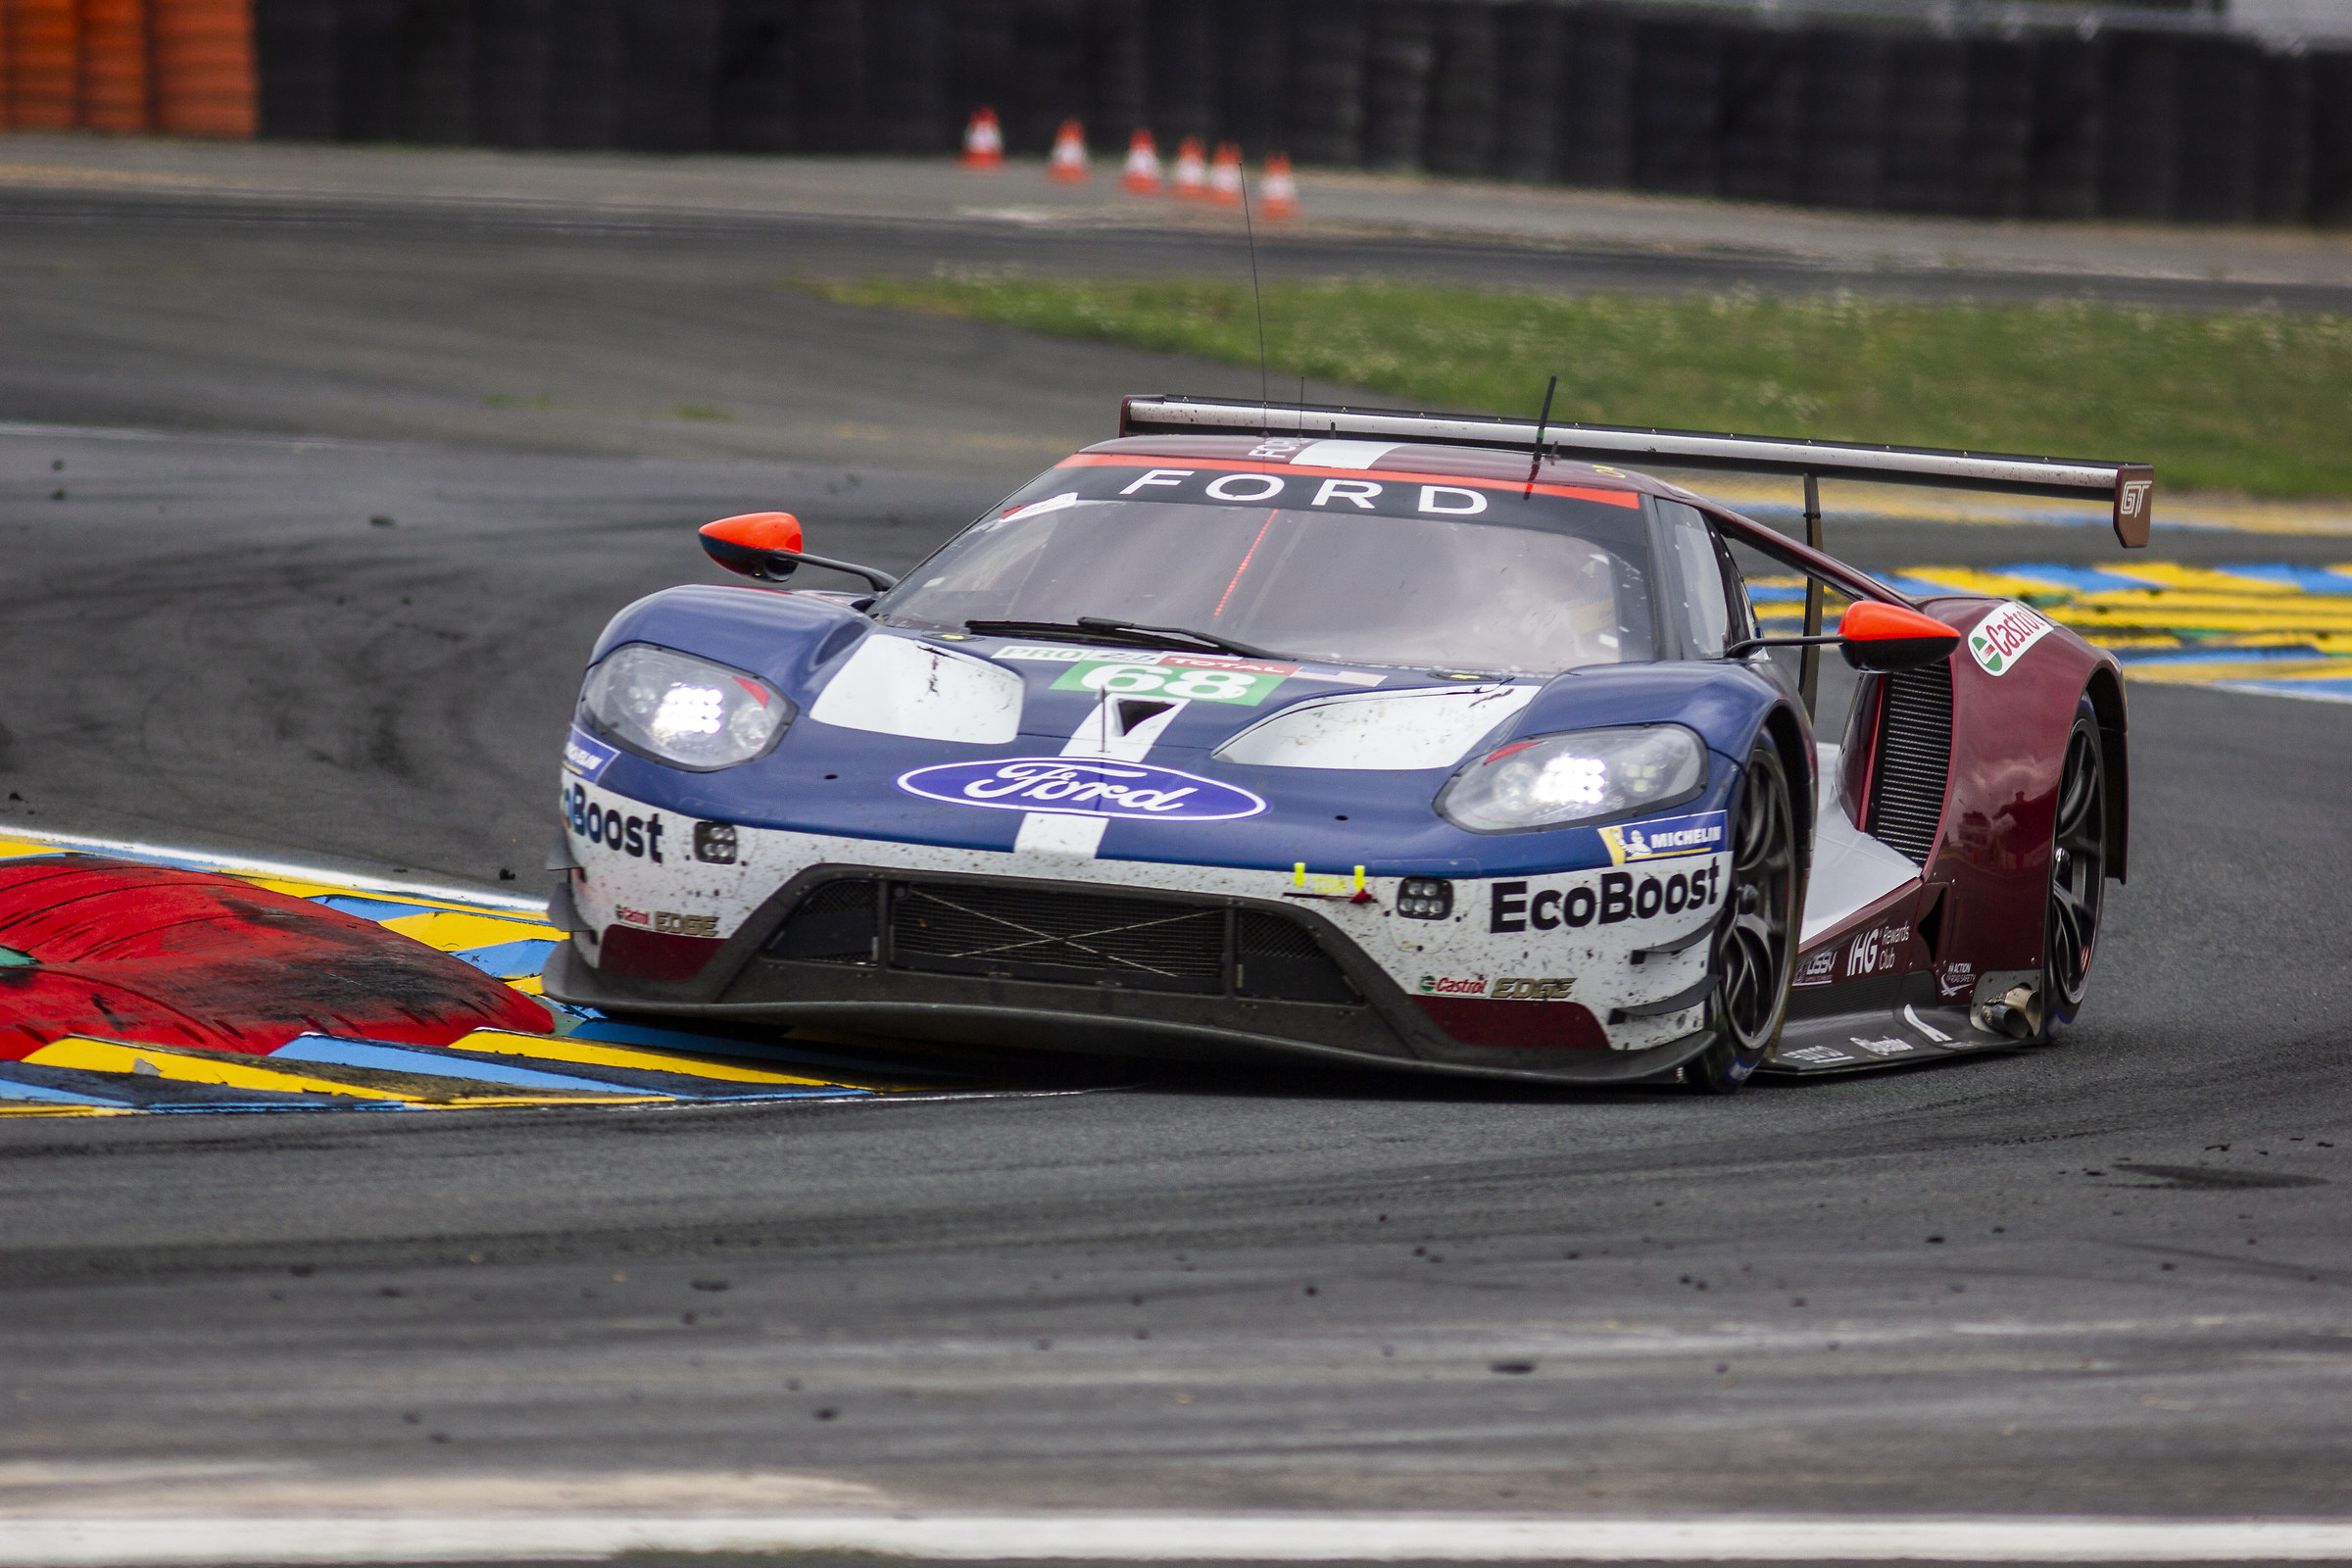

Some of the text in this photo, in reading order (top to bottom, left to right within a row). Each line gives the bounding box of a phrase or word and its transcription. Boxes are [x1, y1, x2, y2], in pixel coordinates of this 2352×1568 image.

[1119, 469, 1489, 514] FORD
[2121, 480, 2152, 518] GT
[1985, 605, 2045, 657] Castrol
[1002, 648, 1085, 661] PRO
[1168, 658, 1285, 673] TOTAL
[1081, 664, 1256, 699] 68
[963, 763, 1199, 811] Ford
[1650, 826, 1722, 849] MICHELIN
[1490, 857, 1719, 933] EcoBoost
[655, 911, 720, 937] EDGE
[1882, 920, 1910, 946] Rewards
[1846, 929, 1879, 977] IHG
[1879, 948, 1895, 970] Club
[1954, 962, 1972, 973] ACTION
[1436, 978, 1577, 999] Castrol EDGE
